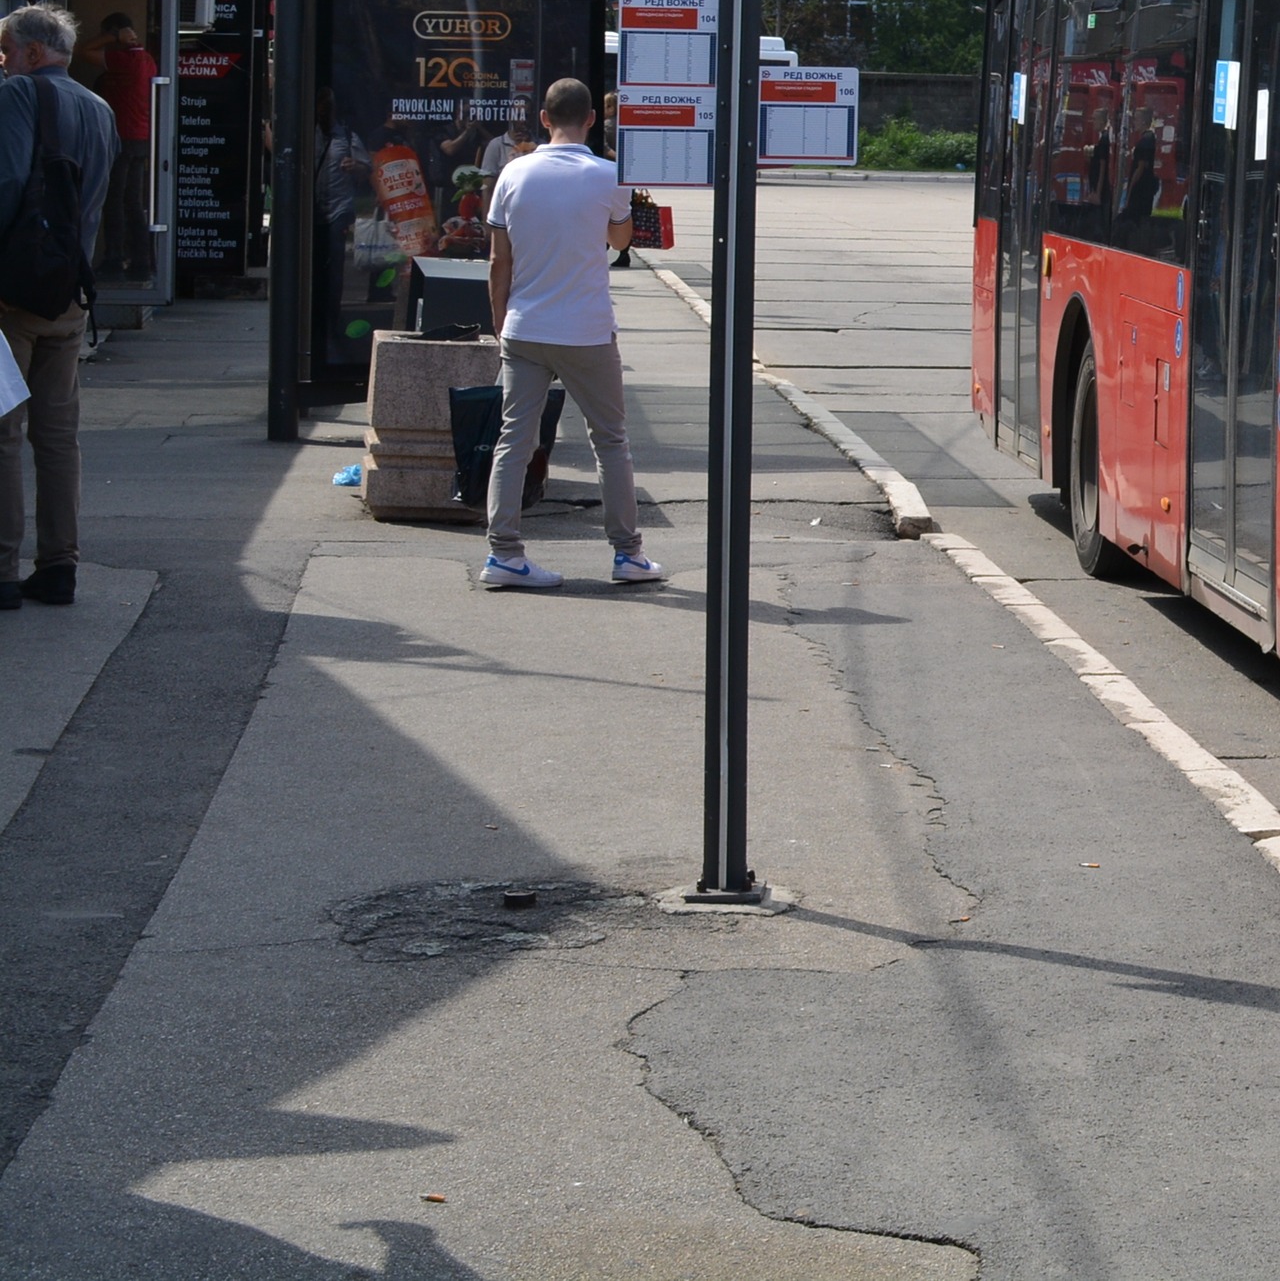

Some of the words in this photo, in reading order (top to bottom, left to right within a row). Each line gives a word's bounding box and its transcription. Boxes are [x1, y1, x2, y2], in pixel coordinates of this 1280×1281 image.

[666, 0, 705, 7] ВОЖЊЕ
[701, 15, 716, 23] 104
[423, 18, 501, 34] YUHOR
[415, 57, 480, 88] 120
[462, 72, 499, 80] GODINA
[783, 71, 803, 80] РЕД
[805, 72, 843, 80] ВОЖЊЕ
[462, 80, 509, 89] TRADICIJE
[840, 88, 855, 96] 106
[180, 96, 207, 108] Struja
[392, 98, 455, 112] PRVOKLASNI
[641, 95, 662, 105] РЕД
[663, 96, 702, 105] ВОЖЊЕ
[469, 107, 527, 121] PROTEINA
[698, 112, 714, 120] 105
[180, 115, 211, 126] Telefon
[180, 135, 226, 145] Komunalne
[181, 146, 209, 157] usluge
[179, 164, 208, 174] Računi
[210, 166, 220, 175] za
[178, 175, 212, 185] mobilne
[178, 198, 220, 207] kablovsku
[179, 209, 190, 219] TV
[197, 210, 231, 220] internet
[177, 227, 206, 238] Uplata
[207, 229, 218, 237] na
[208, 249, 225, 259] lica
